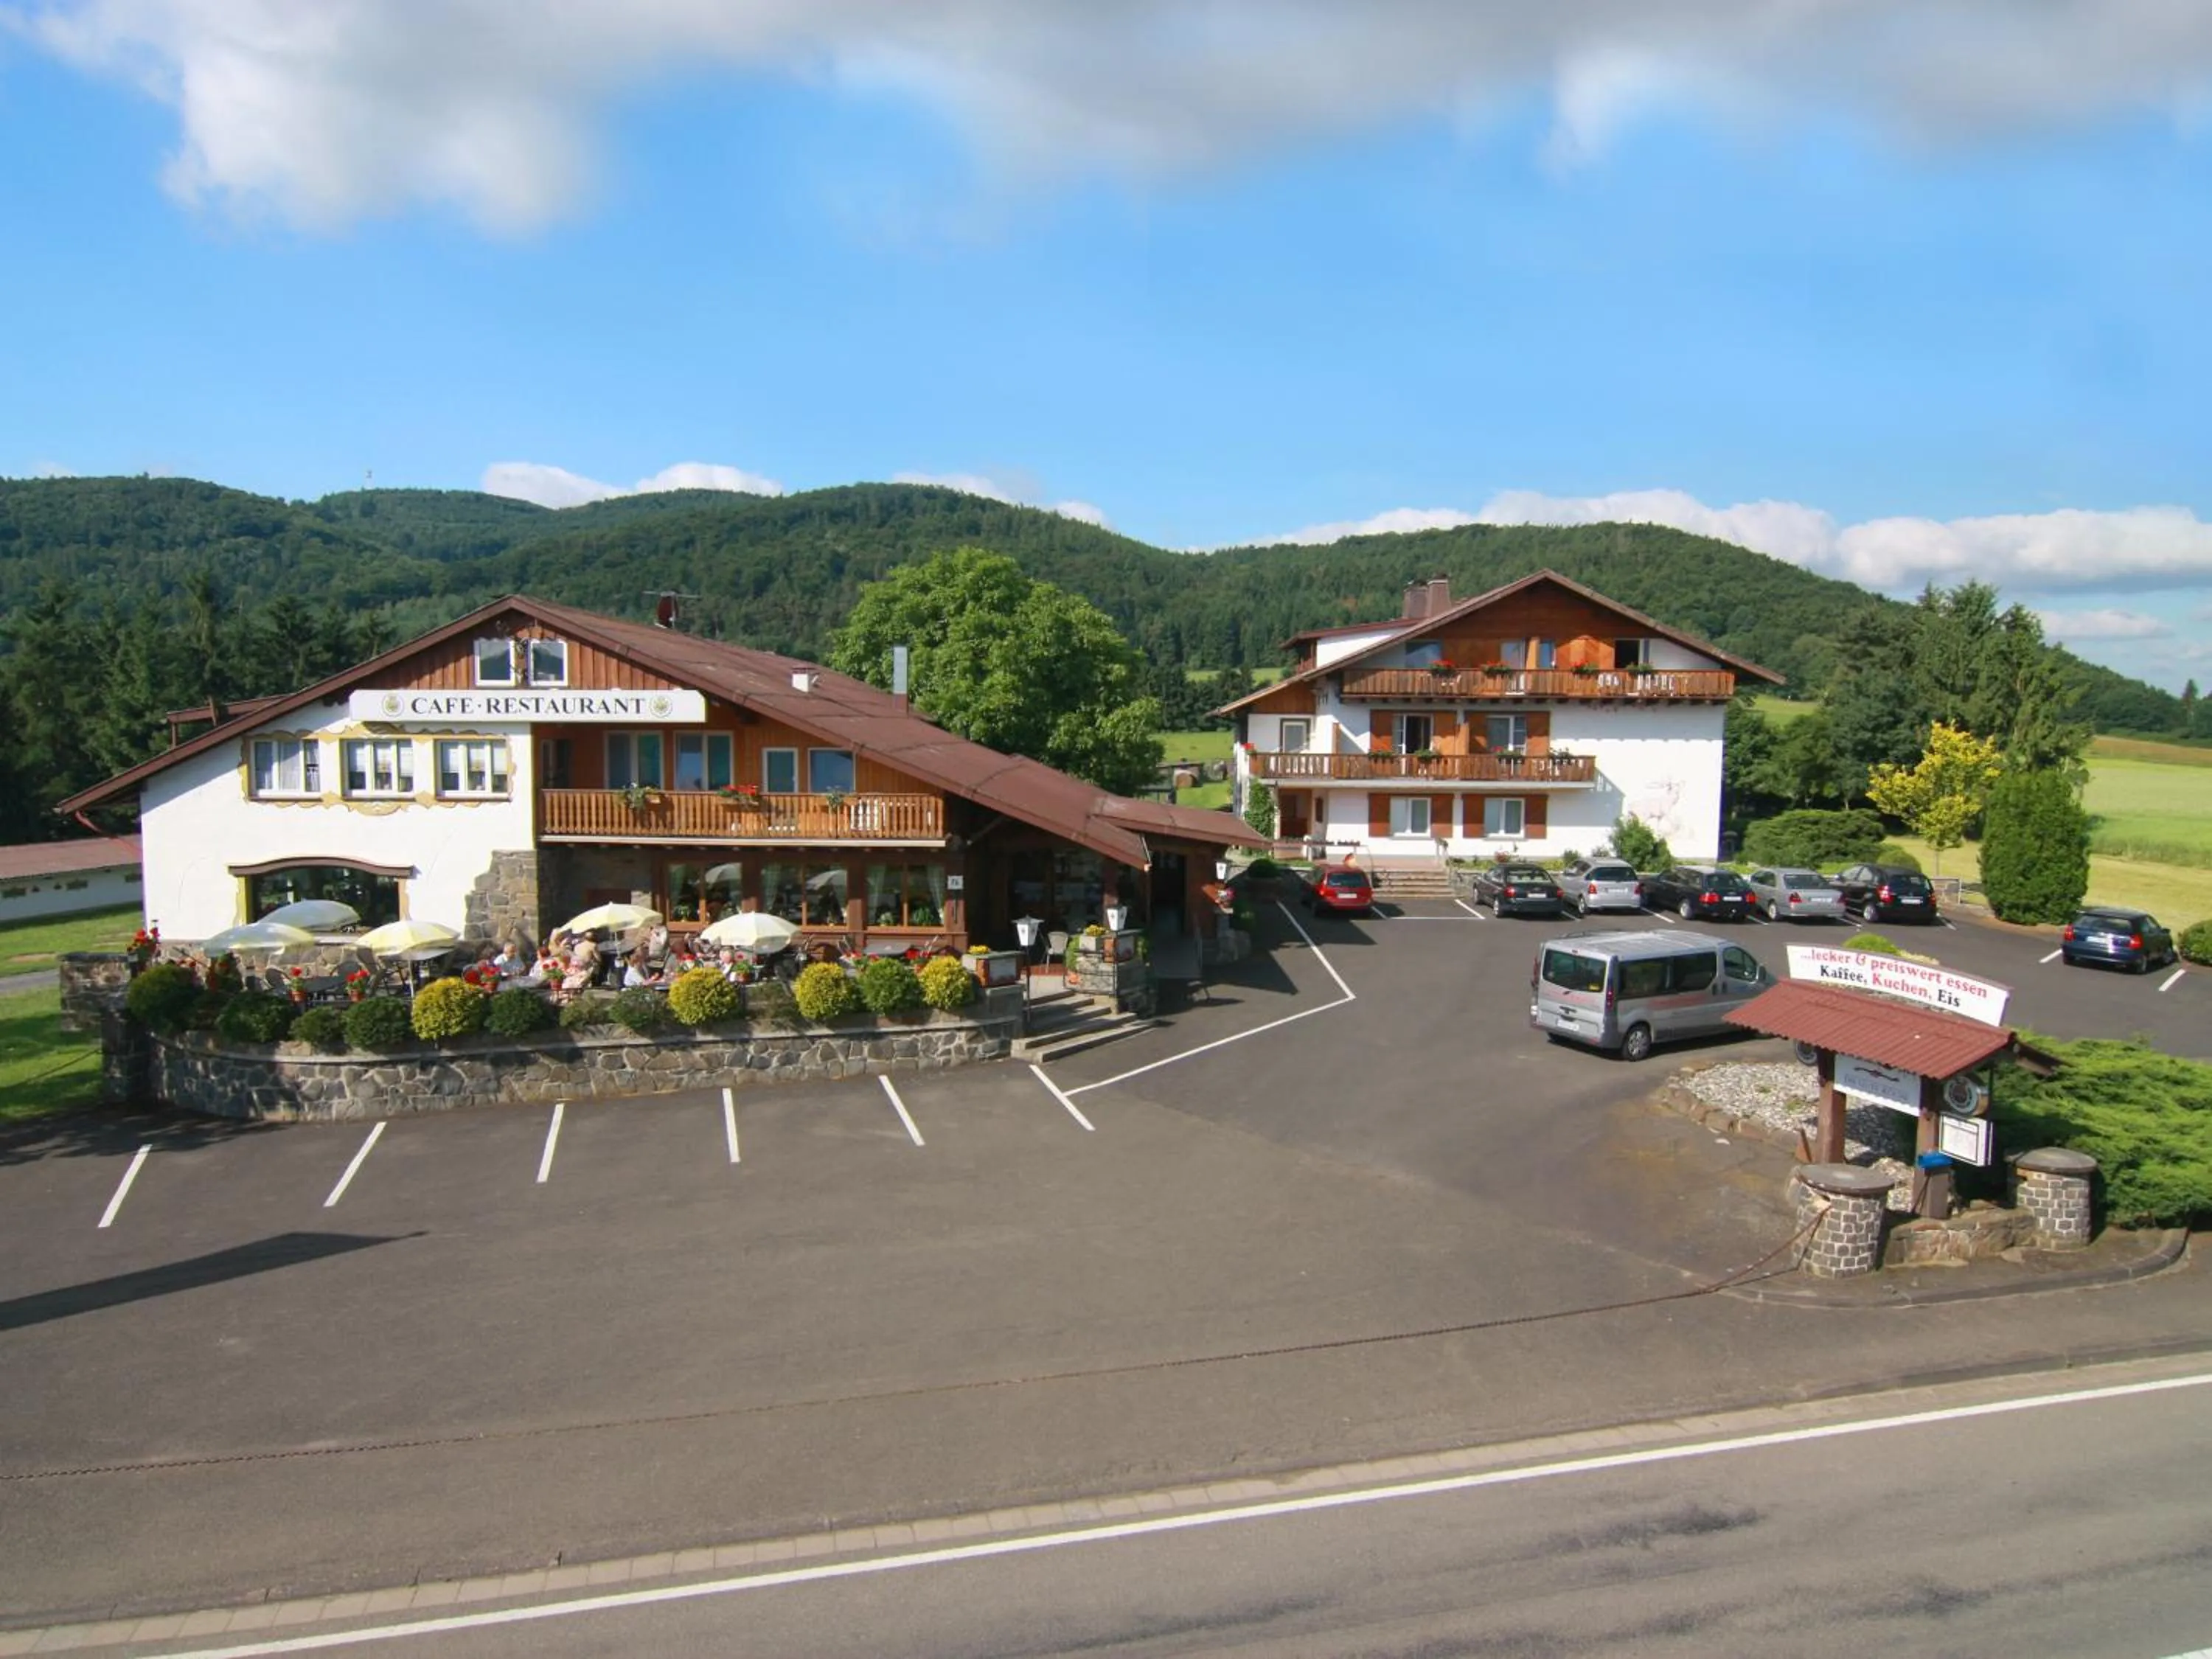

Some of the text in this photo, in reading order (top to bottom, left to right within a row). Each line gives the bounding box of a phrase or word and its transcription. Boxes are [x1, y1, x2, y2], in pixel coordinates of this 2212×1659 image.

[411, 697, 645, 714] CAFE RESTAURANT
[1820, 964, 1961, 1007] Kaffee, Kuchen, Eis
[1871, 959, 1941, 984] preiswert
[1947, 978, 1987, 998] essen
